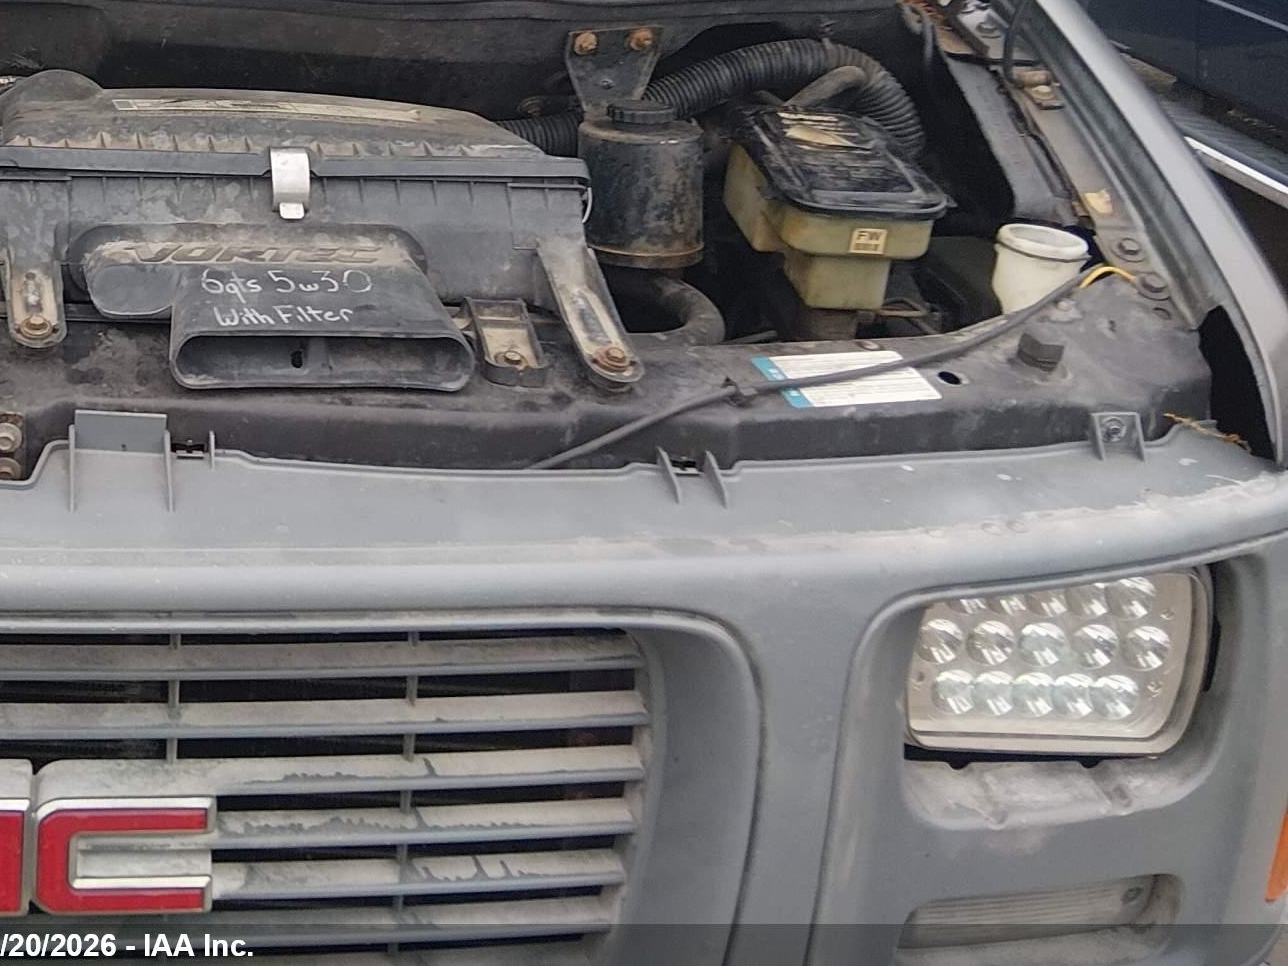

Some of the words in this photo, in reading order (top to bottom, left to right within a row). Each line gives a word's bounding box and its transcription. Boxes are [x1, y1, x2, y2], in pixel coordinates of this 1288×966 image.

[122, 243, 383, 265] VORTEC
[201, 267, 263, 304] 6qts
[213, 305, 276, 327] With
[272, 304, 355, 325] Filter
